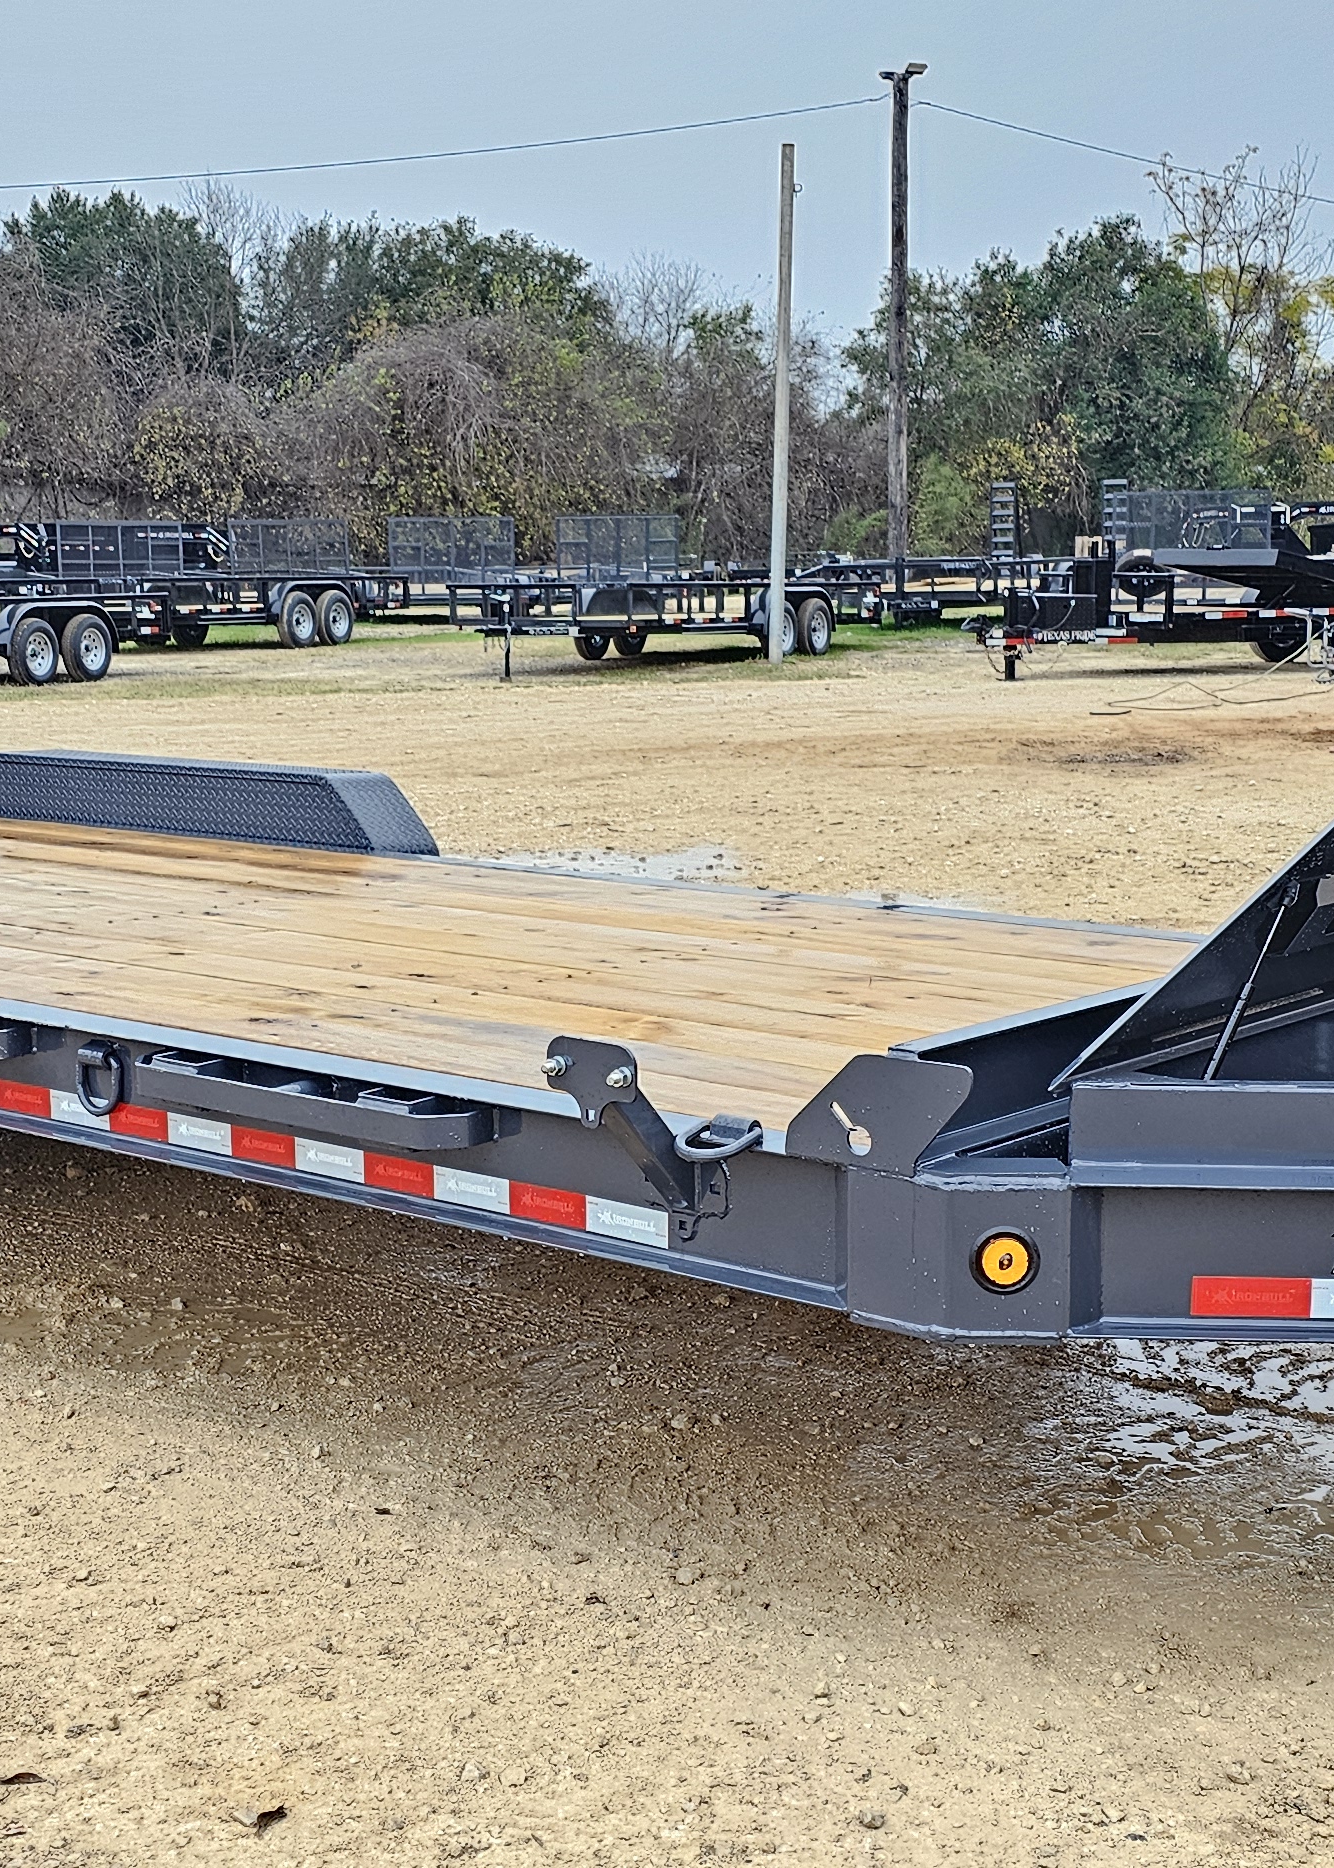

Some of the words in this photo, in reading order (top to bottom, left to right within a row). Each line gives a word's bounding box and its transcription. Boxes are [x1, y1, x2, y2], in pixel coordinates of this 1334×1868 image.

[1041, 630, 1070, 642] TEXAS
[1071, 630, 1097, 642] PRIDE
[613, 1213, 656, 1233] IRONBULL
[1231, 1291, 1295, 1305] IRONBULL
